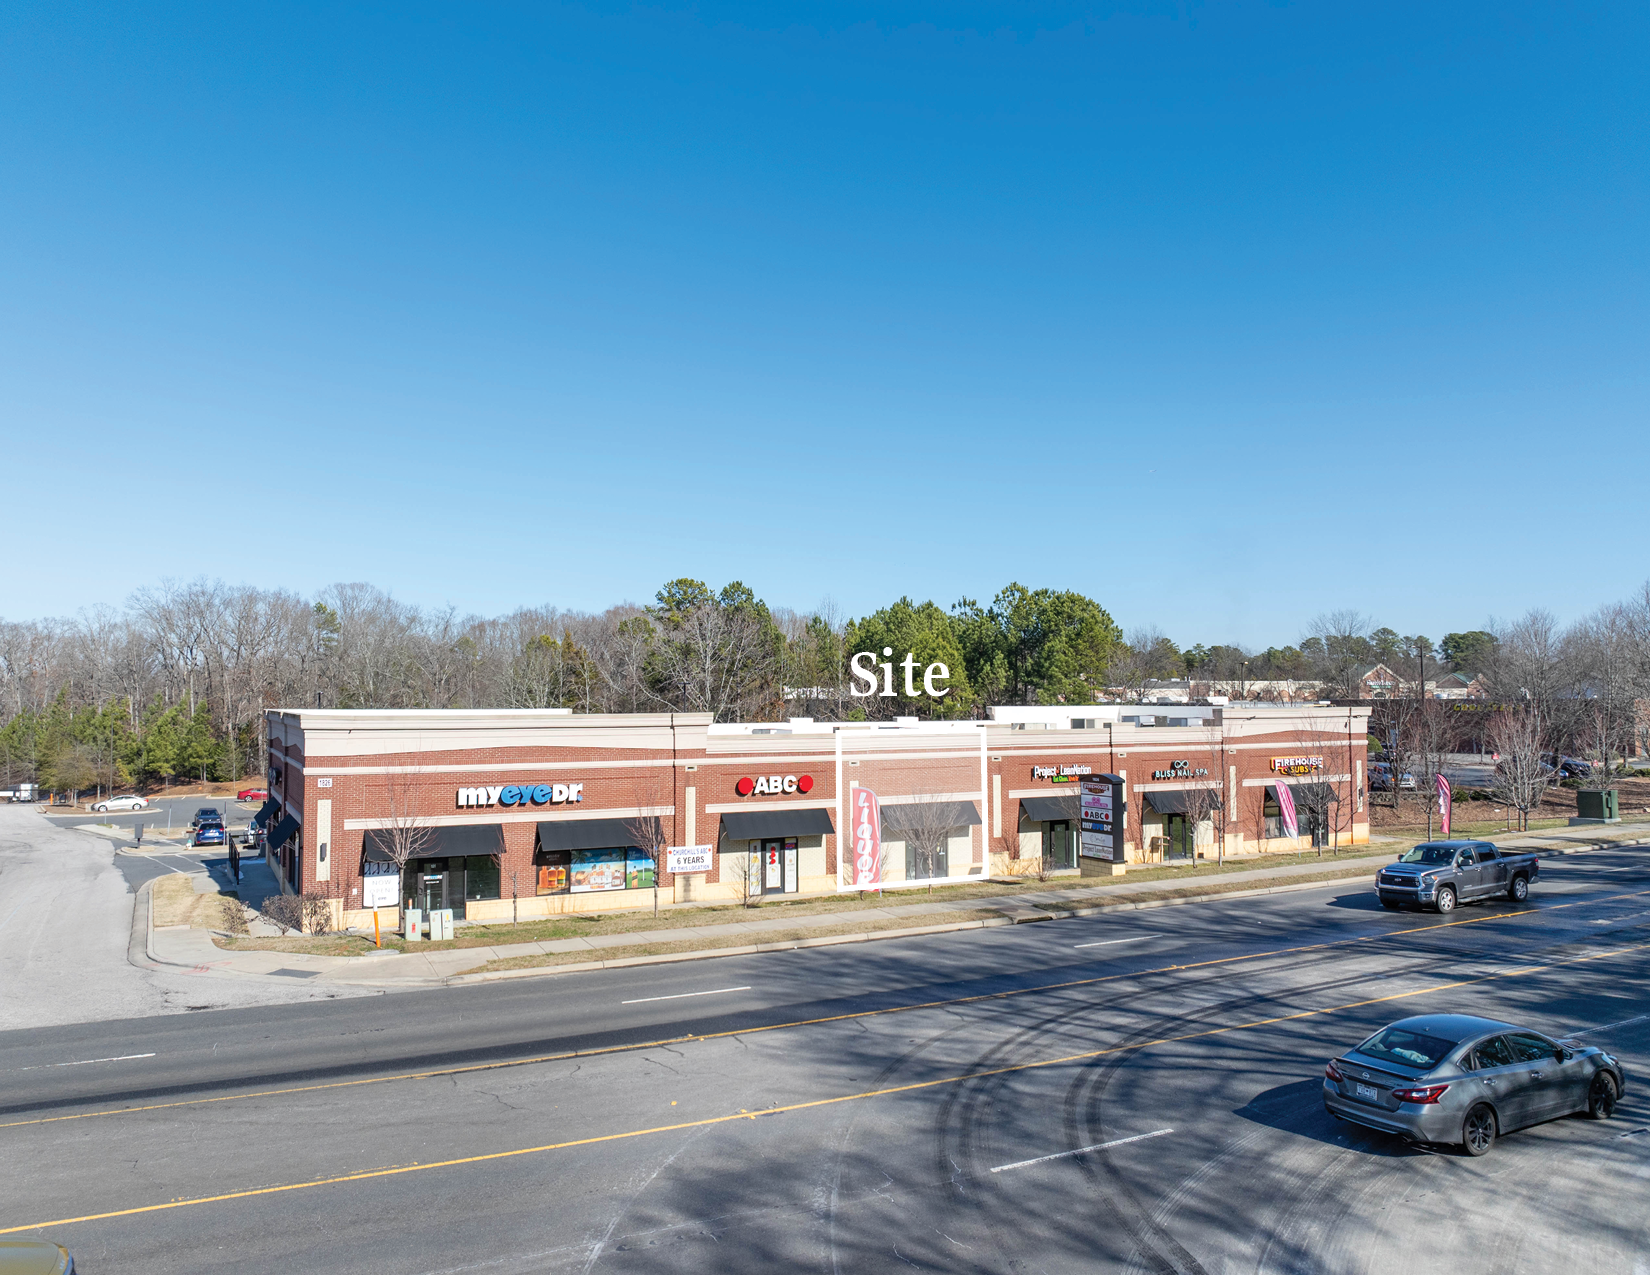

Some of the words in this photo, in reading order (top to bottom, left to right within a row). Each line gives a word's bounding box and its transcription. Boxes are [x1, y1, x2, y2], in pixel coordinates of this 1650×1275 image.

[1274, 757, 1323, 770] FIREHOUSE
[1034, 766, 1057, 779] Project
[1060, 764, 1092, 775] LeanNation
[1155, 769, 1175, 778] BLISS
[1177, 769, 1193, 777] NAIL
[1195, 768, 1208, 776] SPA
[754, 775, 798, 794] ABC
[1089, 811, 1104, 820] ABC
[857, 792, 875, 885] LIQUOR
[676, 857, 681, 865] 6
[683, 856, 705, 865] YEARS
